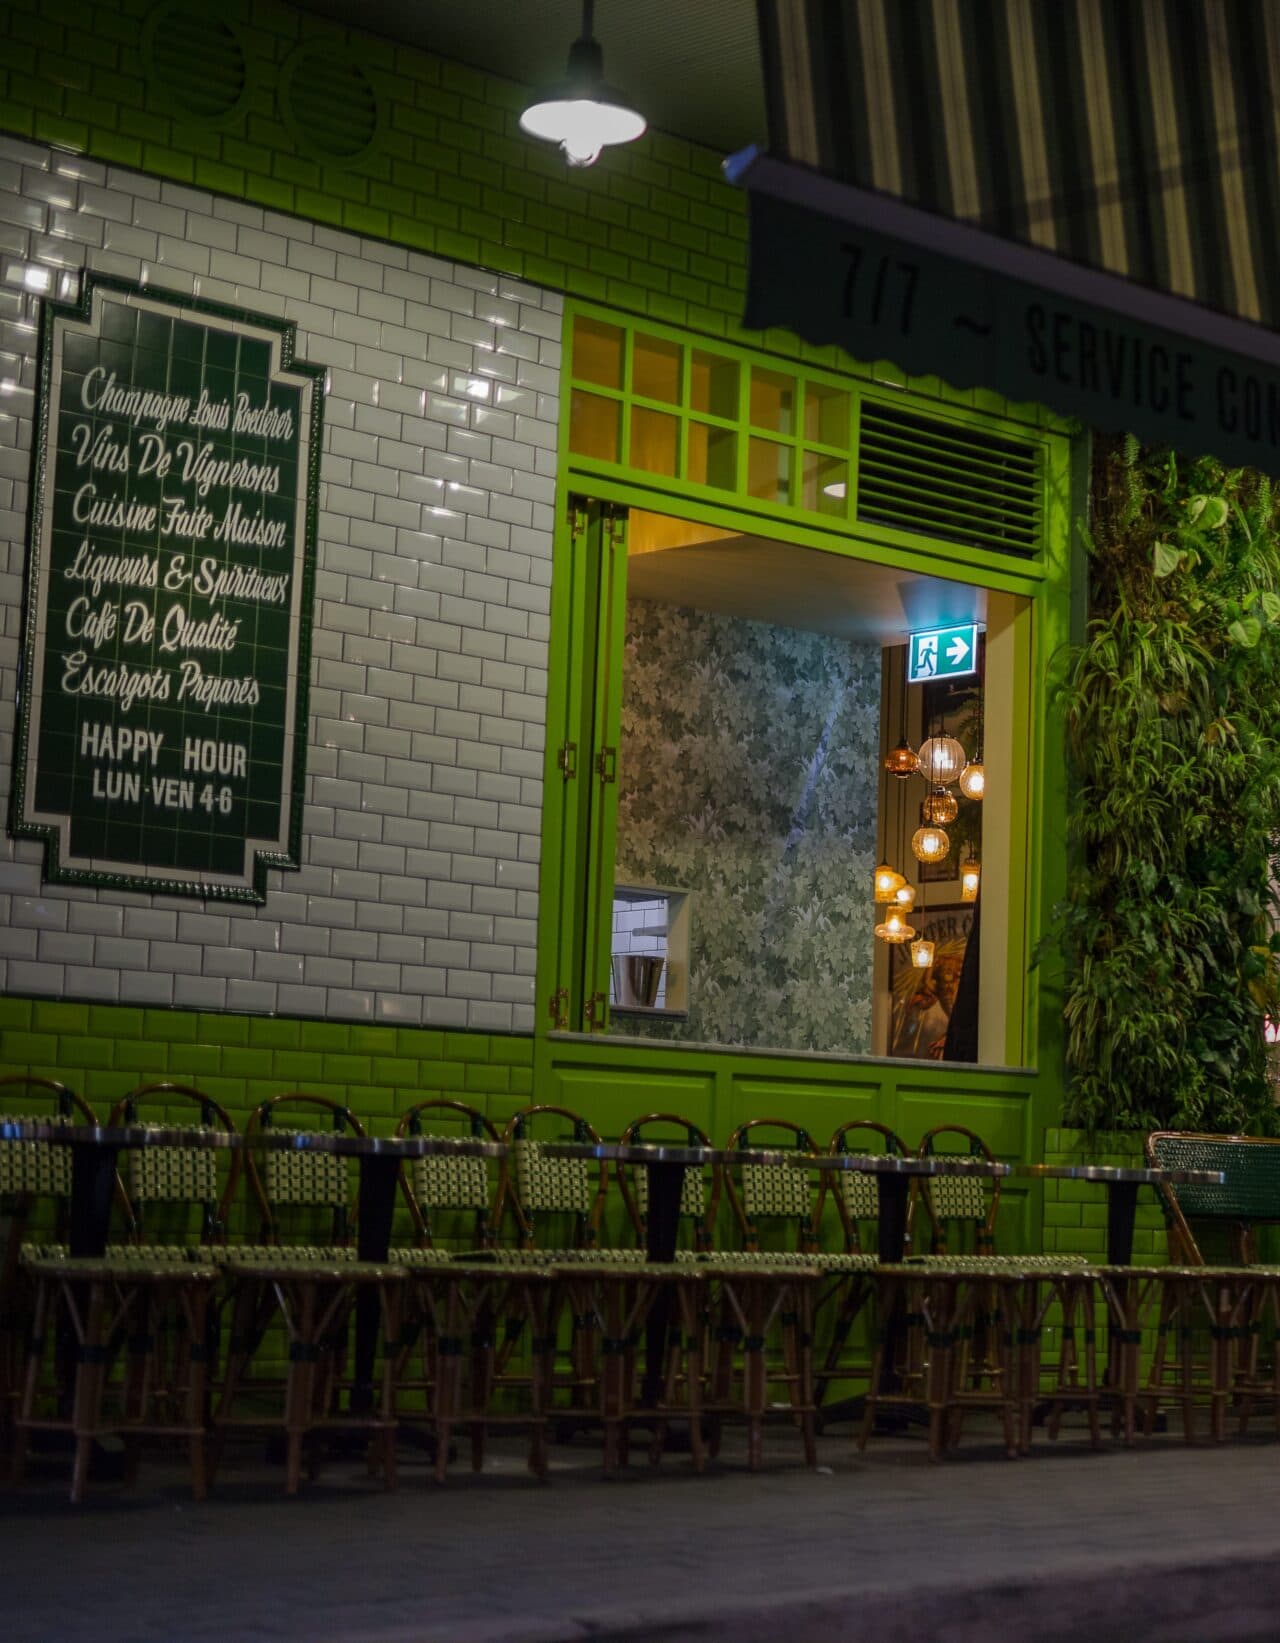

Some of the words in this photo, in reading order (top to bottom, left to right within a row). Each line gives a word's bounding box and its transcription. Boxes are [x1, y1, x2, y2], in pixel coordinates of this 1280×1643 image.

[840, 243, 920, 334] 7/7
[1025, 304, 1196, 423] SERVICE
[82, 366, 190, 431] Champagne
[189, 389, 230, 430] Louis
[232, 393, 295, 441] Roederer
[72, 424, 130, 473] Vins
[137, 434, 172, 478] De
[176, 442, 280, 496] Vignerons
[72, 483, 157, 531] Cuisine
[161, 496, 213, 538] Faite
[213, 503, 287, 548] Maison
[64, 539, 159, 598] Liqueurs
[164, 555, 192, 590] &
[194, 557, 289, 605] Spiritueux
[65, 597, 120, 649] Café
[123, 601, 156, 643] De
[159, 604, 242, 652] Qualité
[61, 650, 170, 712] Escargots
[81, 721, 164, 766] HAPPY
[184, 736, 247, 777] HOUR
[199, 784, 233, 815] 4-6
